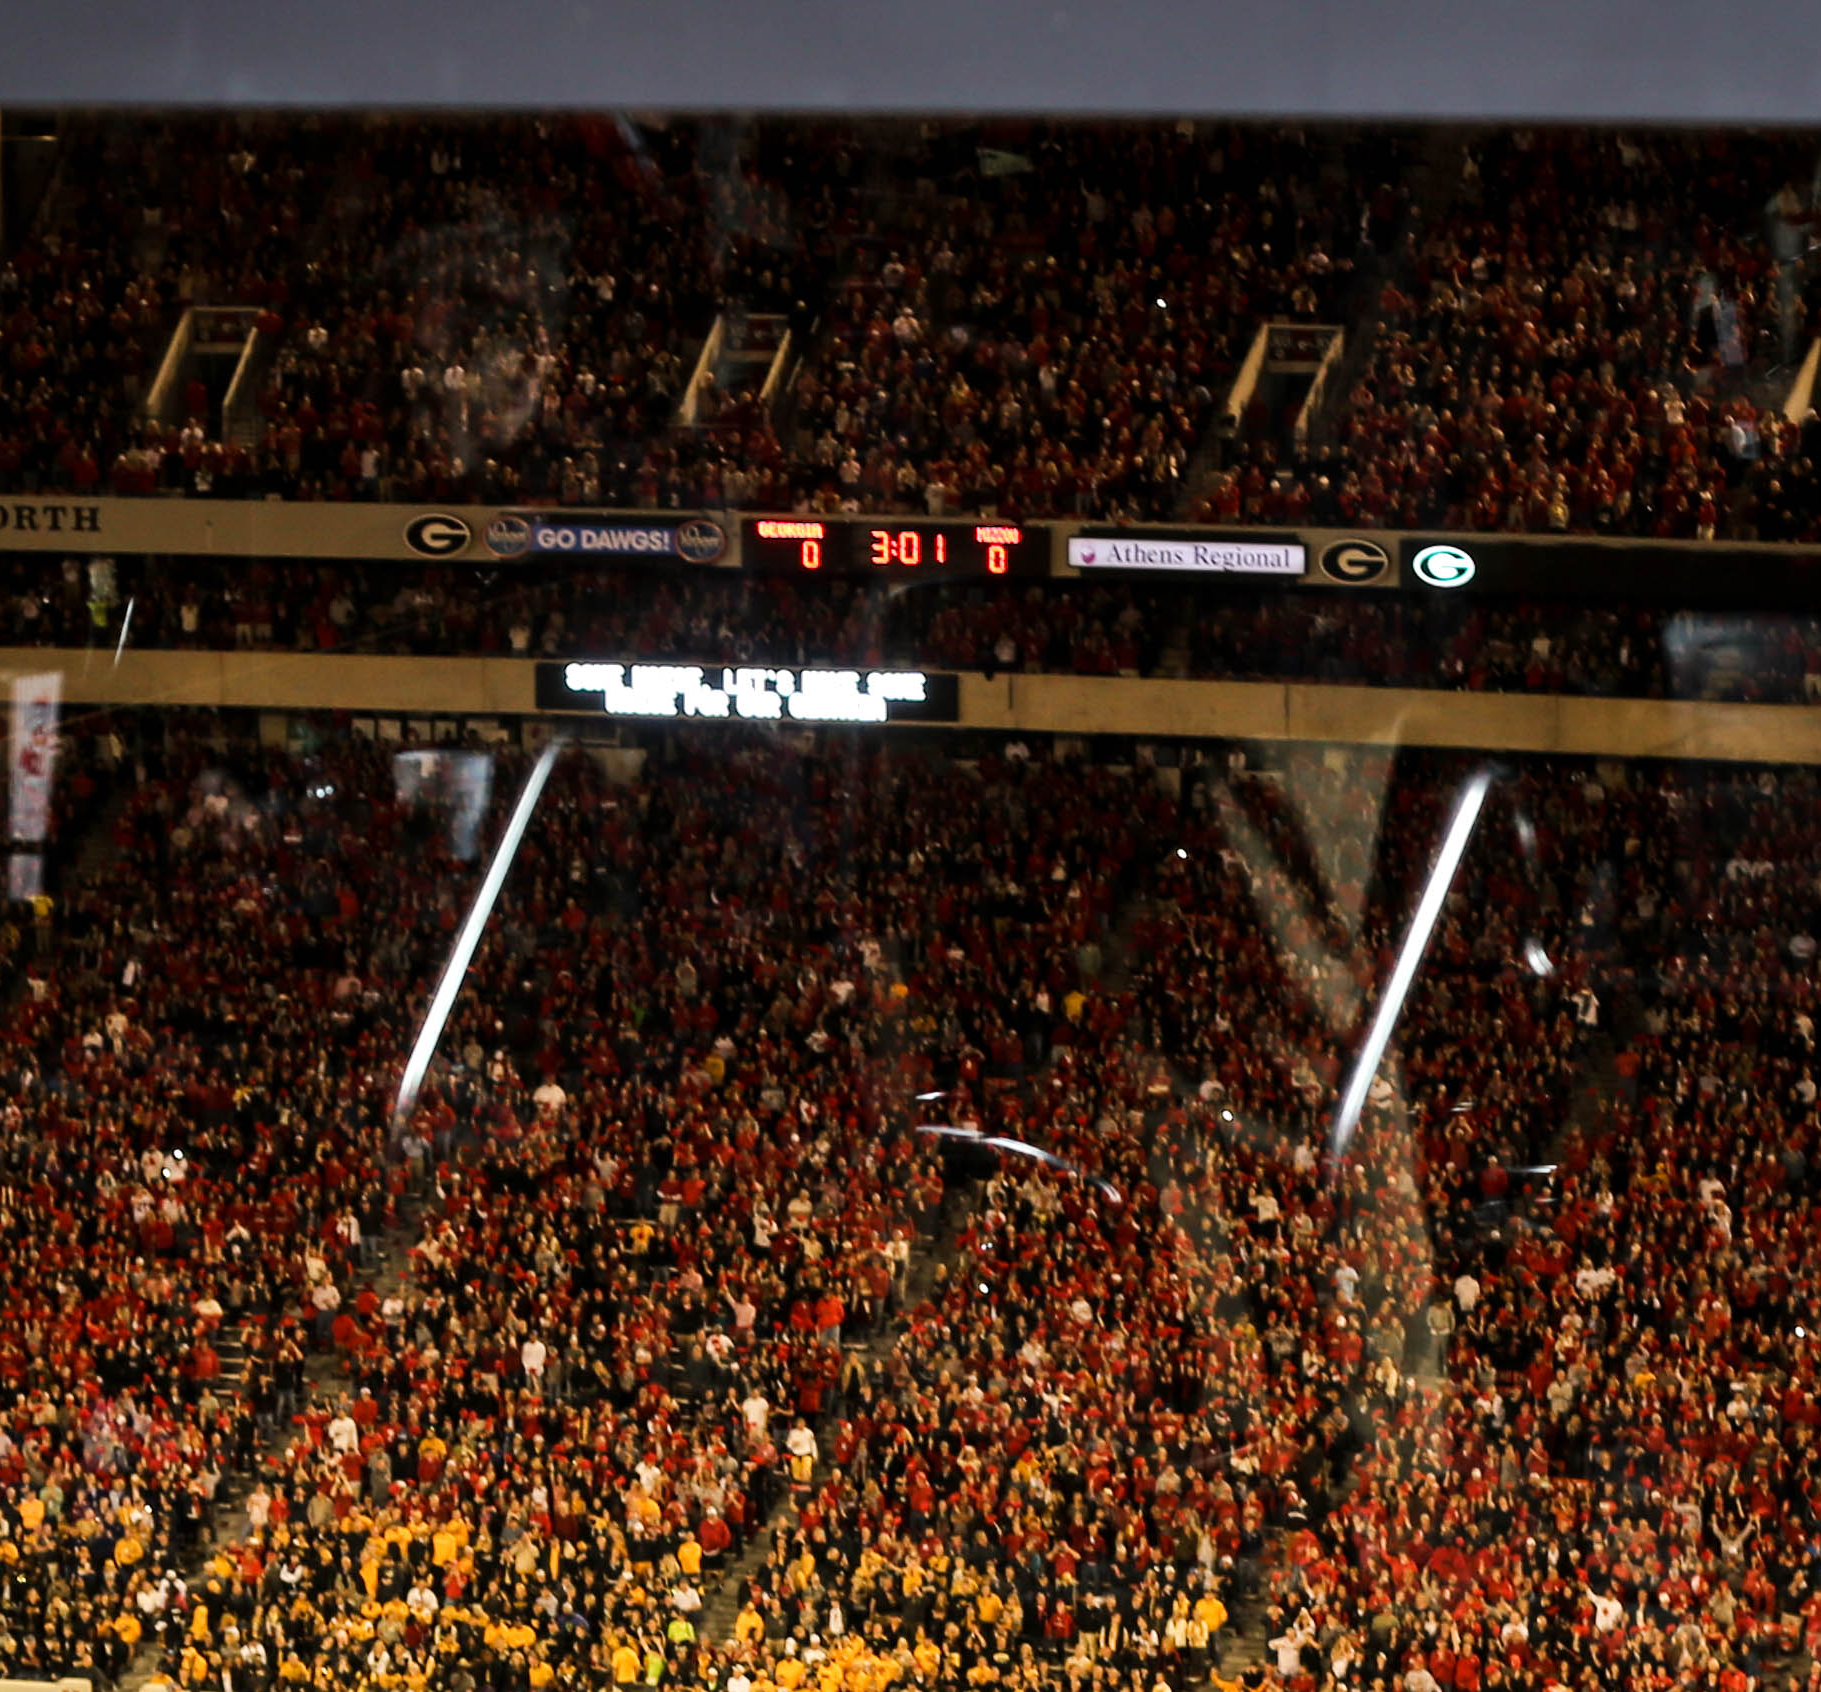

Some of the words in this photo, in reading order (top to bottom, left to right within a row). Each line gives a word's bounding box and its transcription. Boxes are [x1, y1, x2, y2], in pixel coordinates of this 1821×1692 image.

[537, 528, 576, 549] GO
[580, 530, 671, 551] DAWGS!
[758, 520, 824, 539] GEORGIA
[802, 541, 821, 569] 0
[871, 531, 946, 565] 3:01
[988, 545, 1007, 574] 0
[1106, 542, 1183, 565] Athens
[1192, 546, 1291, 573] Regional
